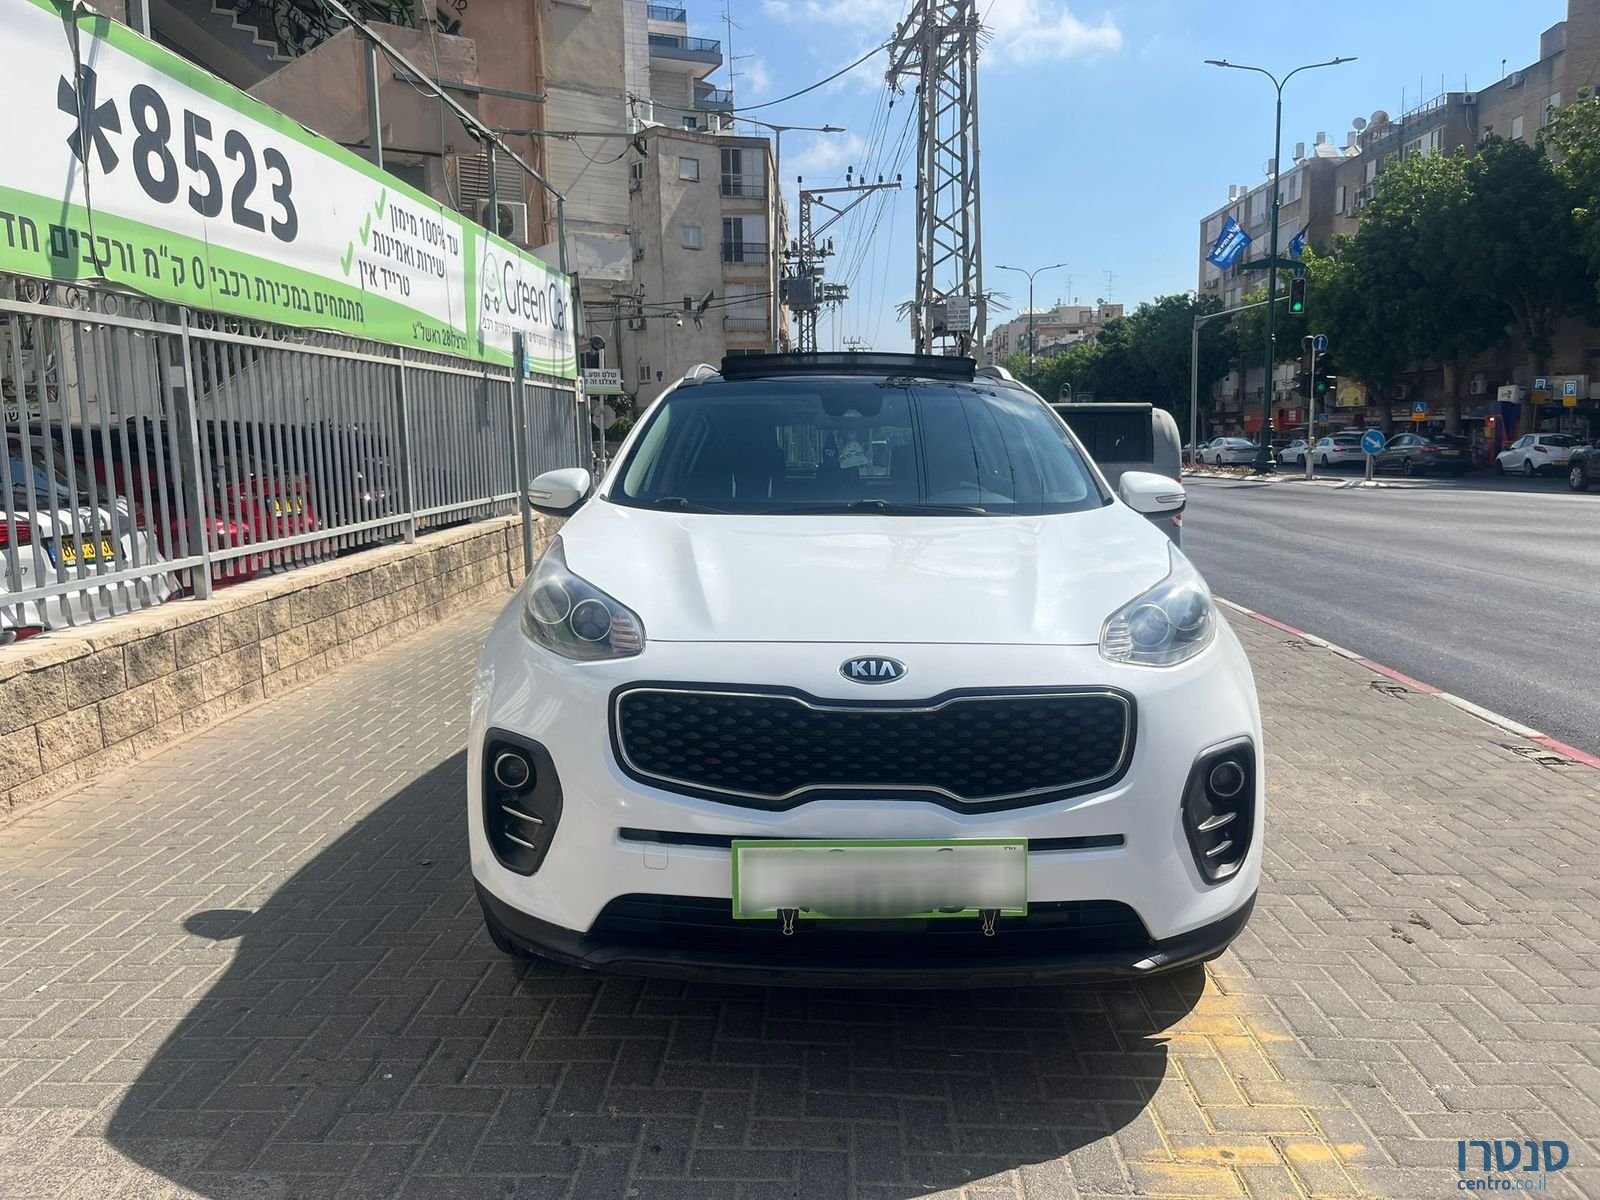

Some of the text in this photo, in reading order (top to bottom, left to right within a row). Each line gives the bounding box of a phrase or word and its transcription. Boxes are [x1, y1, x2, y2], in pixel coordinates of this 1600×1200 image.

[48, 223, 136, 274] ורכבים
[390, 204, 459, 257] עד 100% מימון
[142, 244, 186, 287] ק"מ
[372, 230, 445, 279] שירות ואמינות
[209, 265, 252, 300] רכבי
[254, 276, 312, 312] במכירת
[358, 259, 411, 297] טרייד אין
[503, 260, 568, 333] Green Car
[313, 291, 365, 323] מתמחים
[851, 660, 896, 676] KIA
